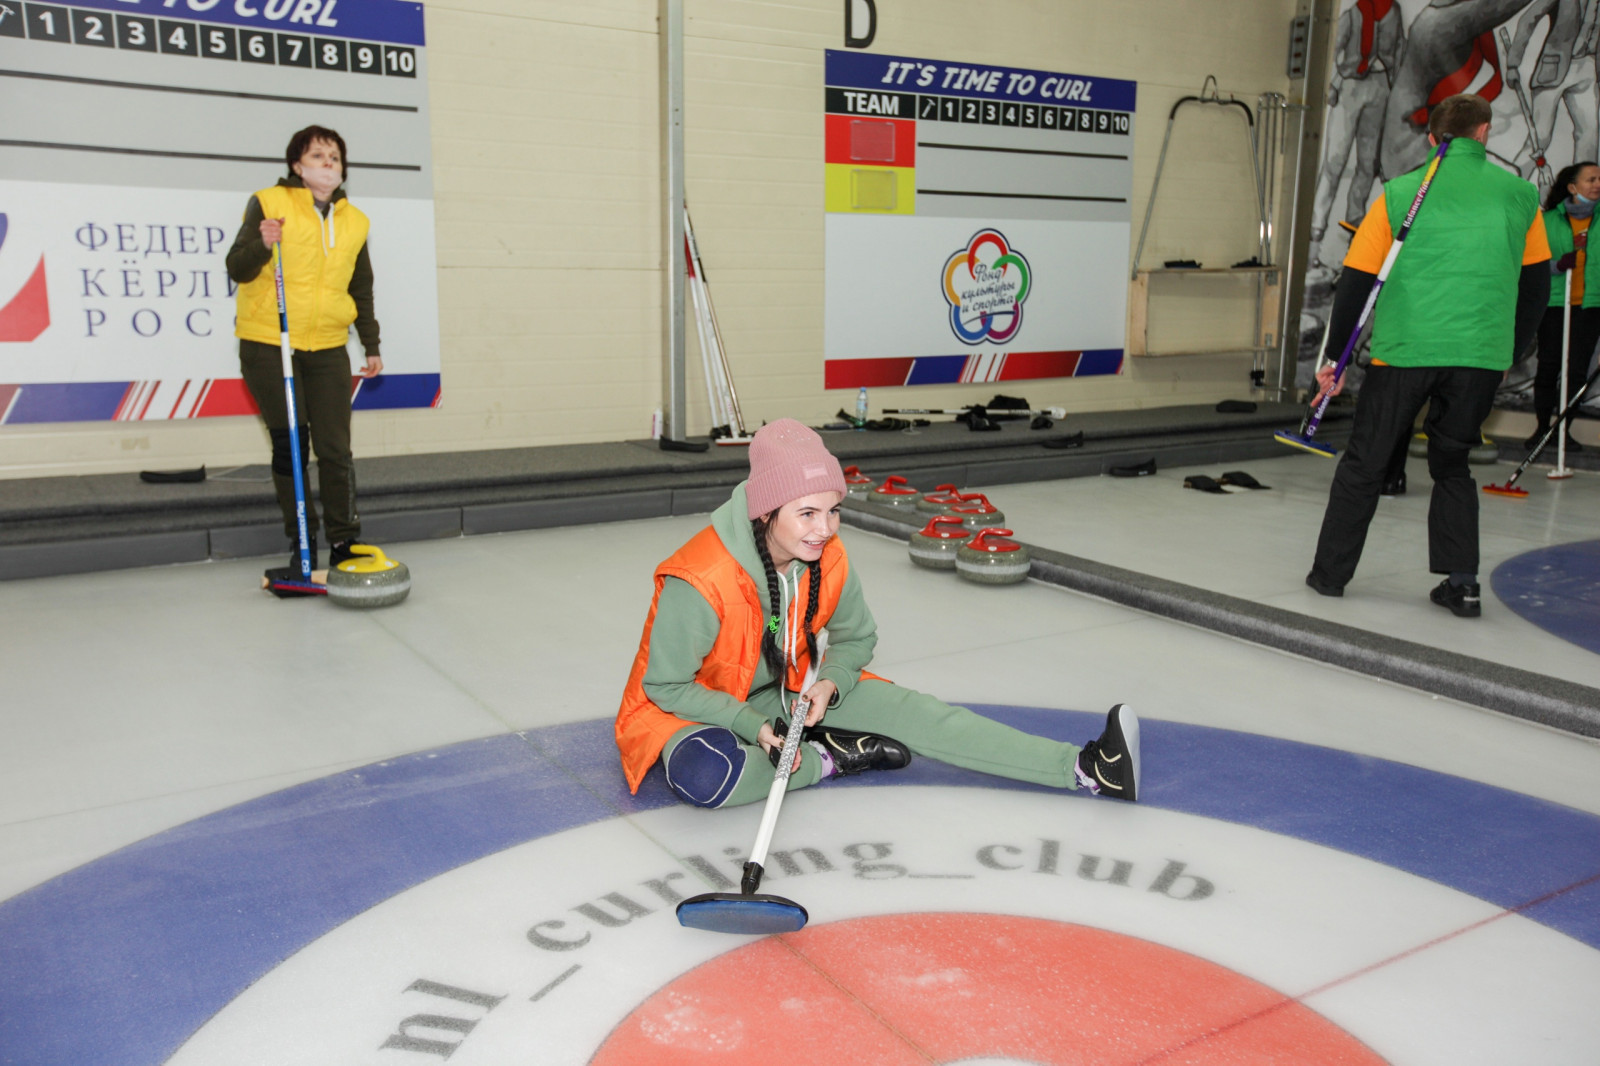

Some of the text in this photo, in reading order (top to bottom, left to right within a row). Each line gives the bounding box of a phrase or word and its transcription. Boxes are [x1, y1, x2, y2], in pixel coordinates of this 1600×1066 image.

[234, 0, 338, 27] CURL
[844, 0, 877, 49] D
[39, 11, 414, 73] 1 2 3 4 5 6 7 8 9 10
[941, 67, 1003, 93] TIME
[1005, 74, 1036, 96] TO
[1040, 77, 1092, 102] CURL
[843, 91, 1129, 131] TEAM 1 2 3 4 5 6 7 8 9 10
[75, 222, 225, 259] ФЕДЕР
[83, 308, 237, 338] РОС
